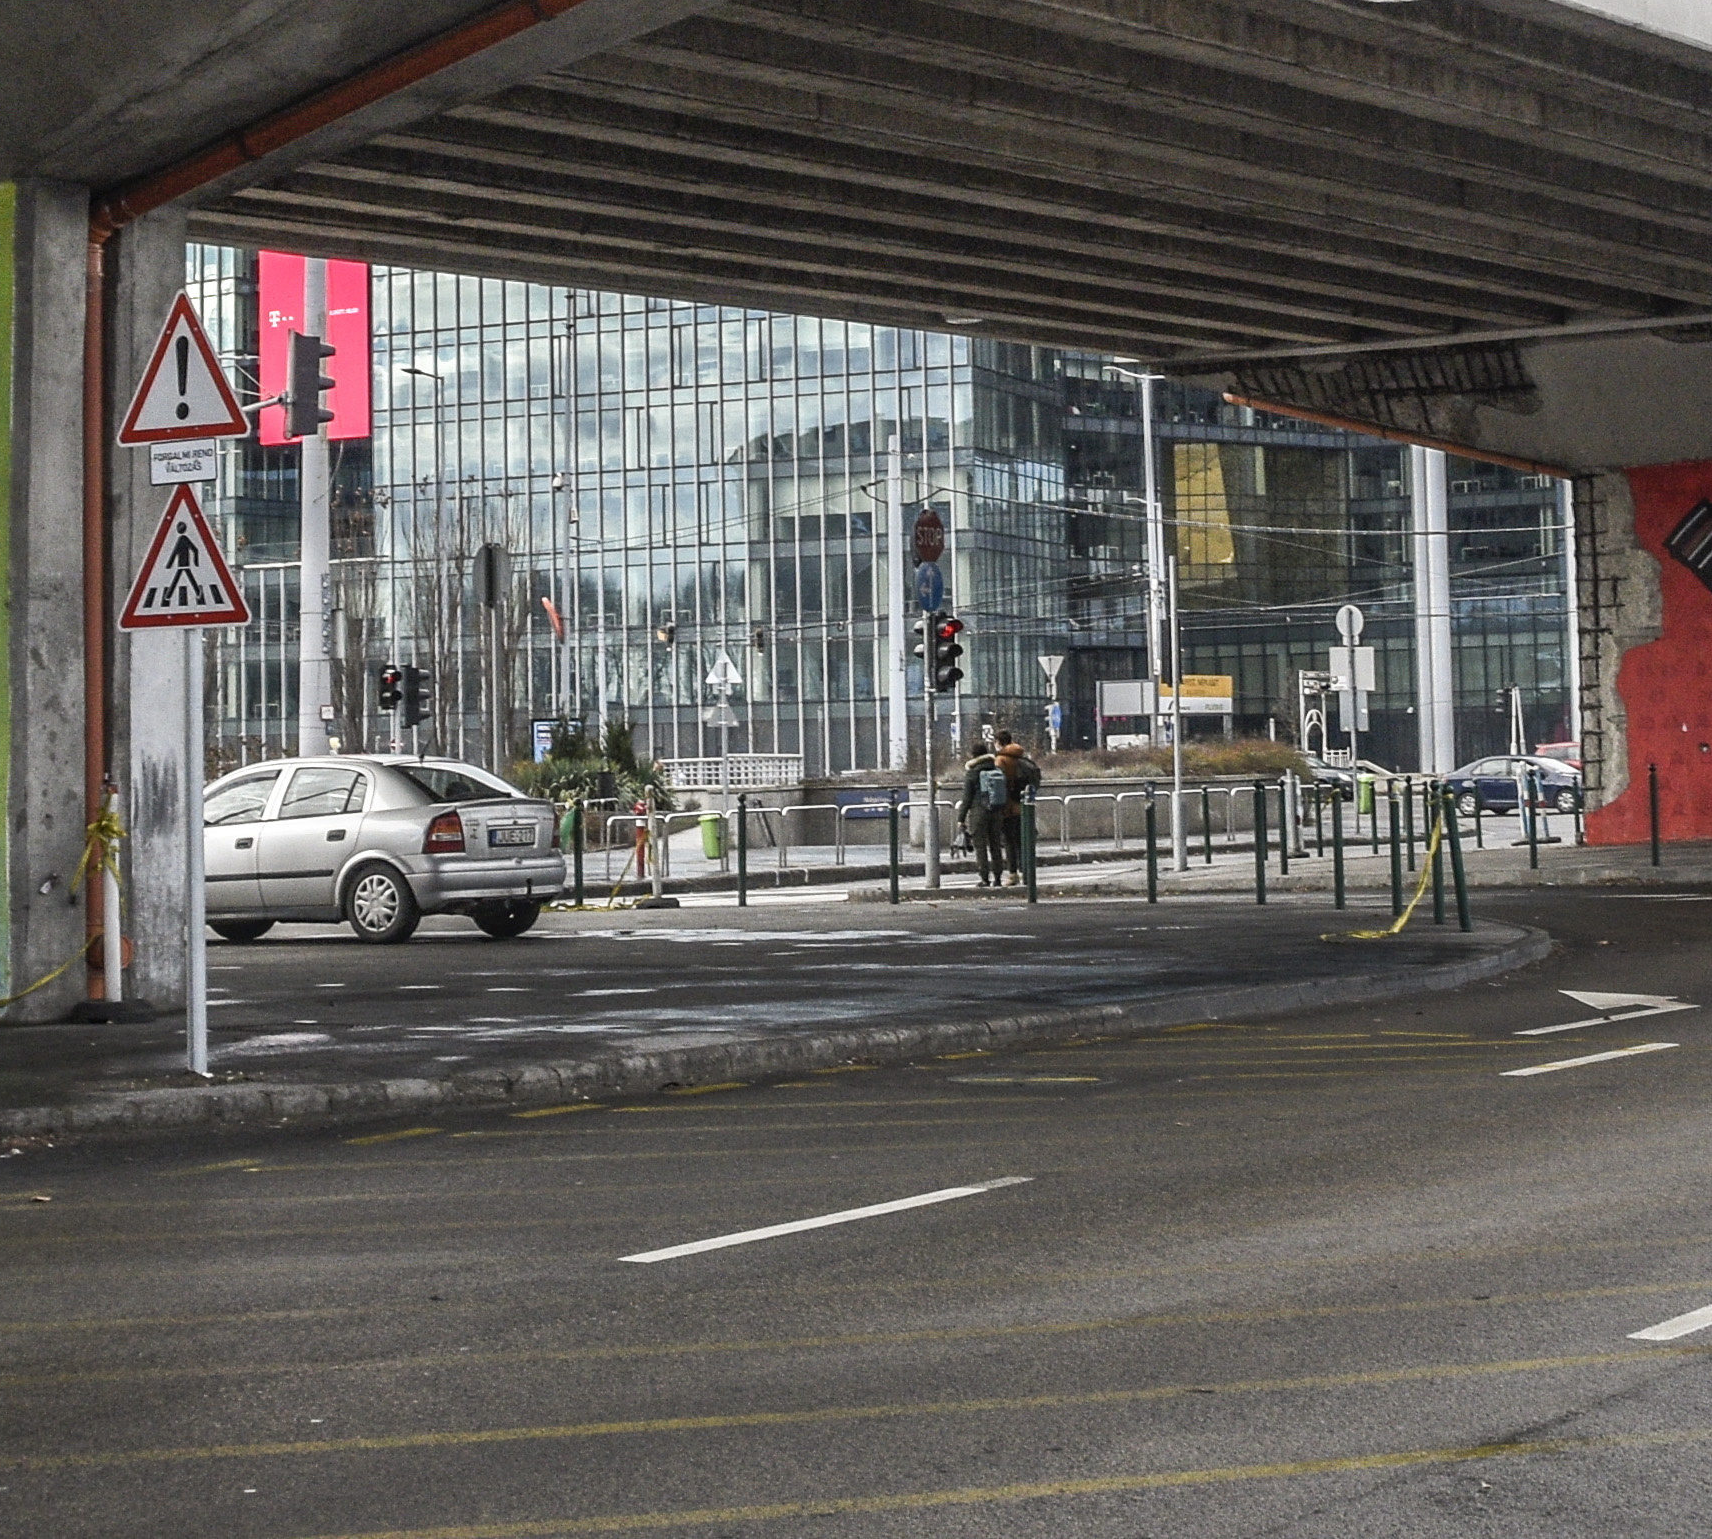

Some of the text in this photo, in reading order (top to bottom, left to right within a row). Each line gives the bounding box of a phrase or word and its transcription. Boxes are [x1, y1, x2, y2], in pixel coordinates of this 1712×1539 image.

[153, 448, 213, 461] FORGALMI REND
[916, 526, 943, 546] STOP
